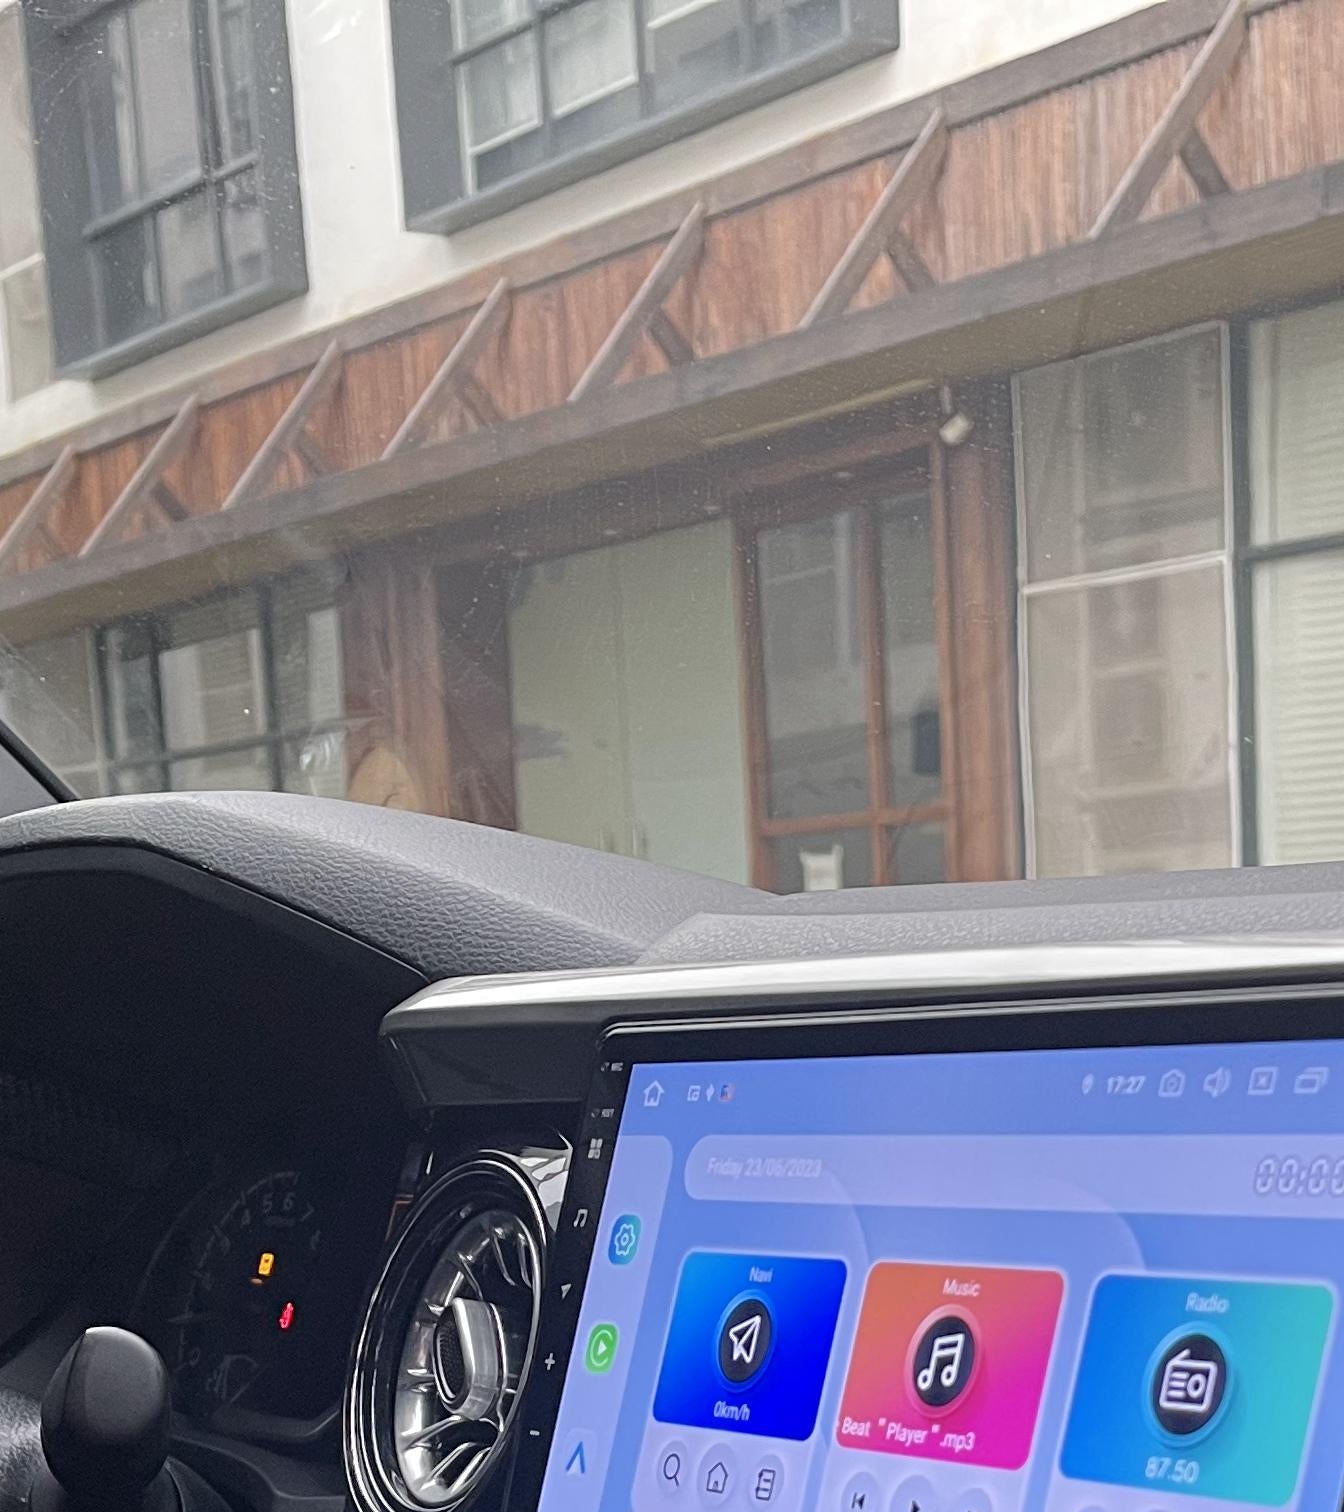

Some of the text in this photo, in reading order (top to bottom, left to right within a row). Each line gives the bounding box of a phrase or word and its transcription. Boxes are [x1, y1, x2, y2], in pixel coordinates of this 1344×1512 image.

[1107, 1075, 1146, 1094] 17:27
[706, 1157, 743, 1180] Friday
[749, 1266, 773, 1283] Navi
[943, 1278, 980, 1298] Music
[1185, 1292, 1230, 1313] Radio
[713, 1400, 750, 1421] 0km/h
[841, 1416, 871, 1437] Beat
[1144, 1456, 1199, 1484] 87.50
